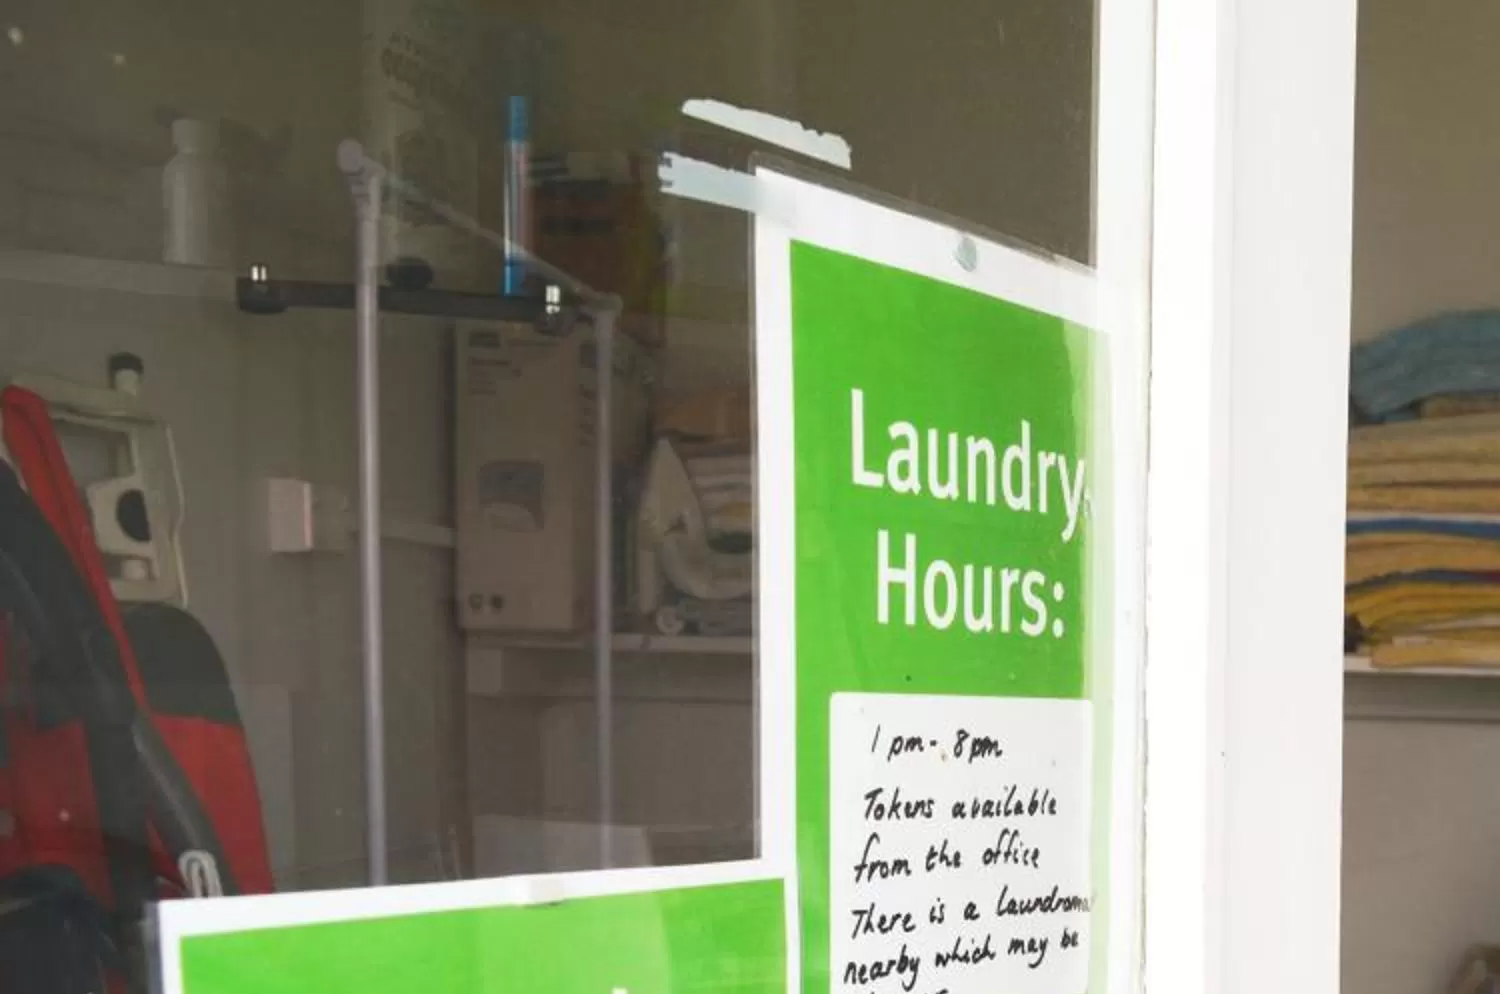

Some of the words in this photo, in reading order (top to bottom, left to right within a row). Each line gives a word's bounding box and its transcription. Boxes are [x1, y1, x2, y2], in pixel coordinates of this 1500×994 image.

[852, 388, 1086, 543] Laundry
[876, 528, 1065, 638] Hours:
[864, 787, 935, 821] Tokens
[951, 784, 1057, 819] available
[853, 831, 912, 883] from
[925, 839, 961, 872] the
[982, 828, 1040, 869] office
[851, 902, 916, 939] There
[929, 897, 945, 925] is
[963, 903, 981, 921] a
[843, 945, 921, 991] nearby
[934, 934, 996, 968] which
[1007, 937, 1049, 969] may
[1060, 928, 1079, 949] be
